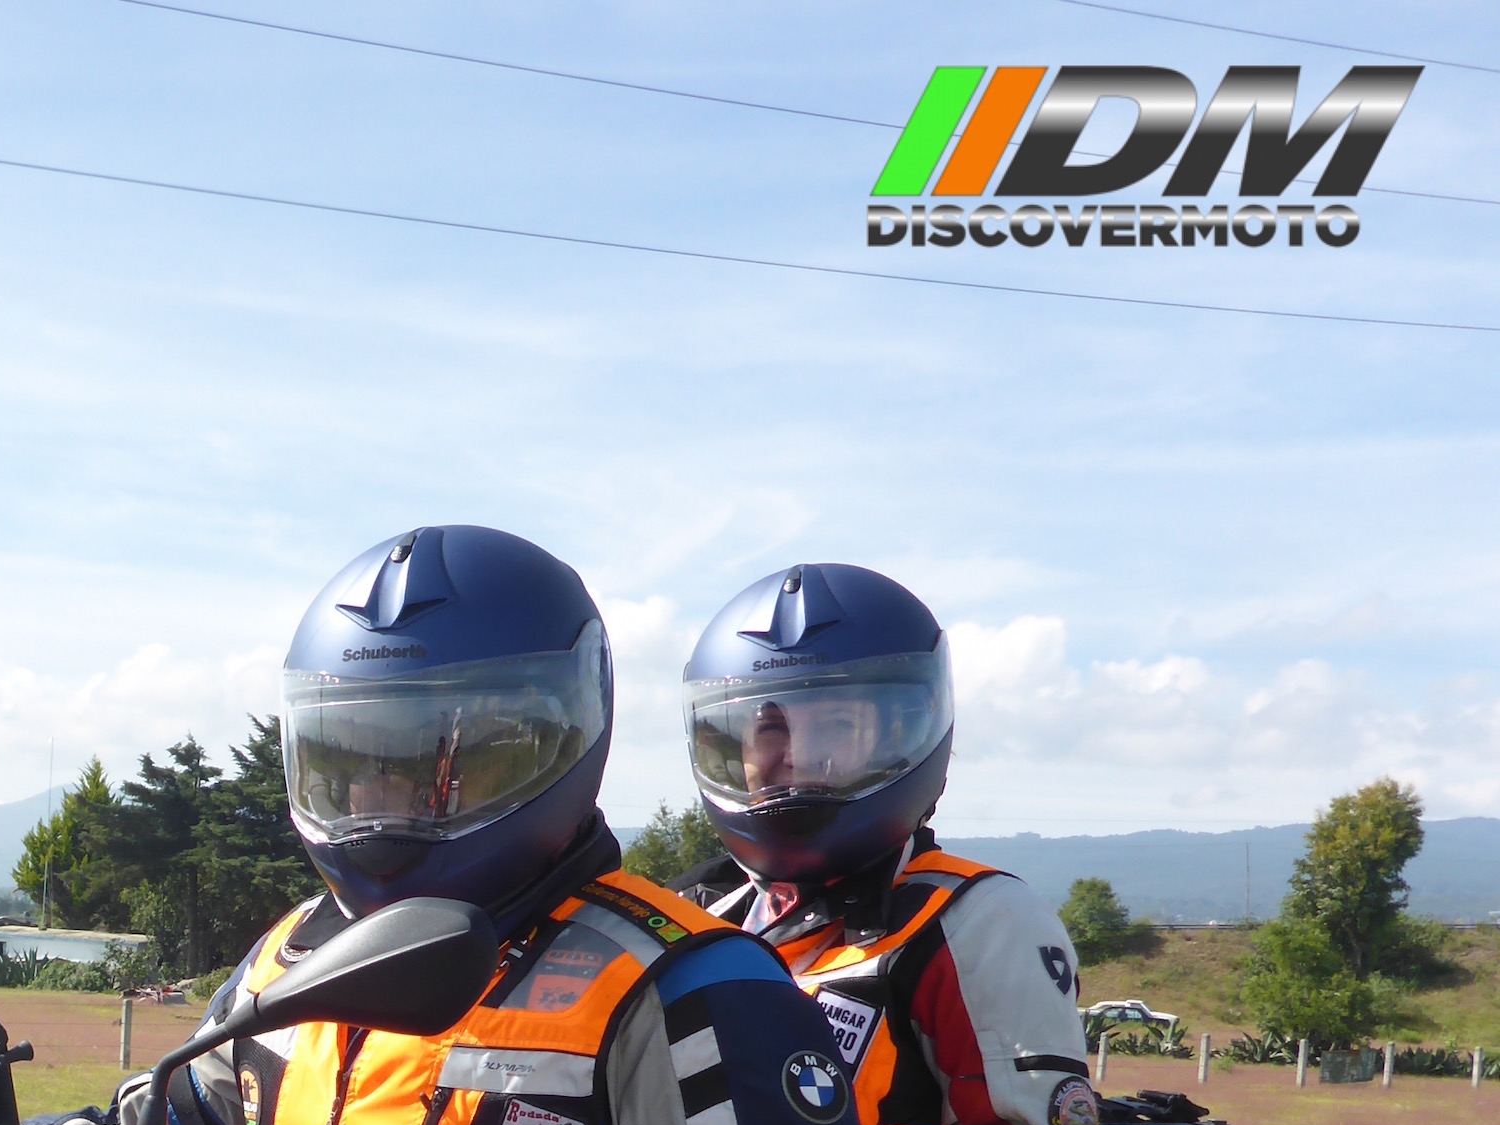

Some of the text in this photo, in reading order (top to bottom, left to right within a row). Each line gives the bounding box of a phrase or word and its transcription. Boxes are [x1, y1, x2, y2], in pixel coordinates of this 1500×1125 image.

[342, 644, 427, 662] Schuberth
[790, 1055, 838, 1077] BMW
[507, 1103, 559, 1123] Rodada
